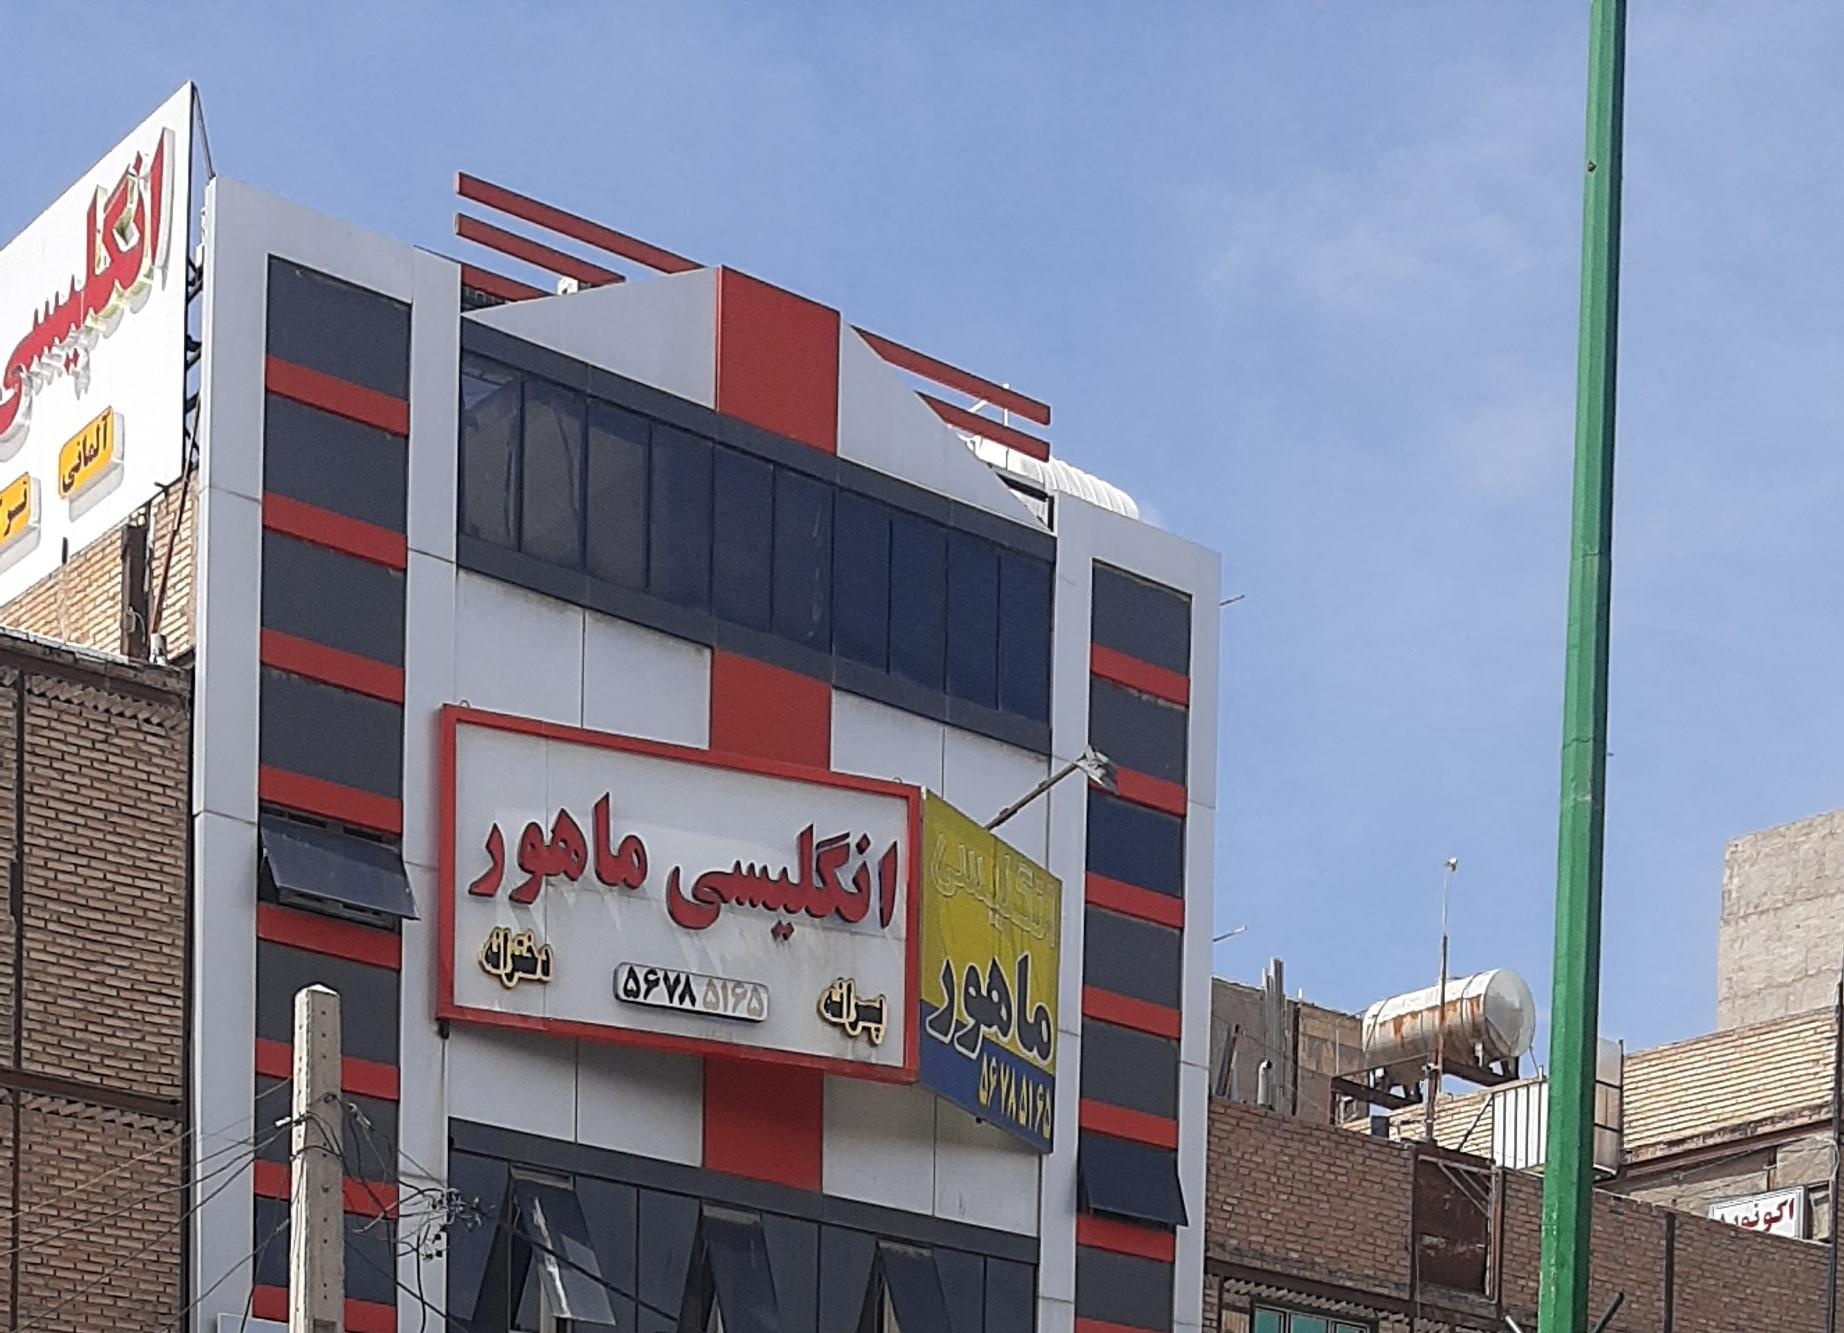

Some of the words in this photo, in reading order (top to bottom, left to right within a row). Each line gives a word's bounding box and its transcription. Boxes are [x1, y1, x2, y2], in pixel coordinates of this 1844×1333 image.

[0, 128, 166, 436] انگلیسی
[61, 412, 111, 493] آلمانی
[468, 792, 649, 905] ماهور
[666, 824, 898, 941] انگلیسی
[931, 835, 1057, 950] انگلیسی
[926, 950, 1054, 1067] ماهور
